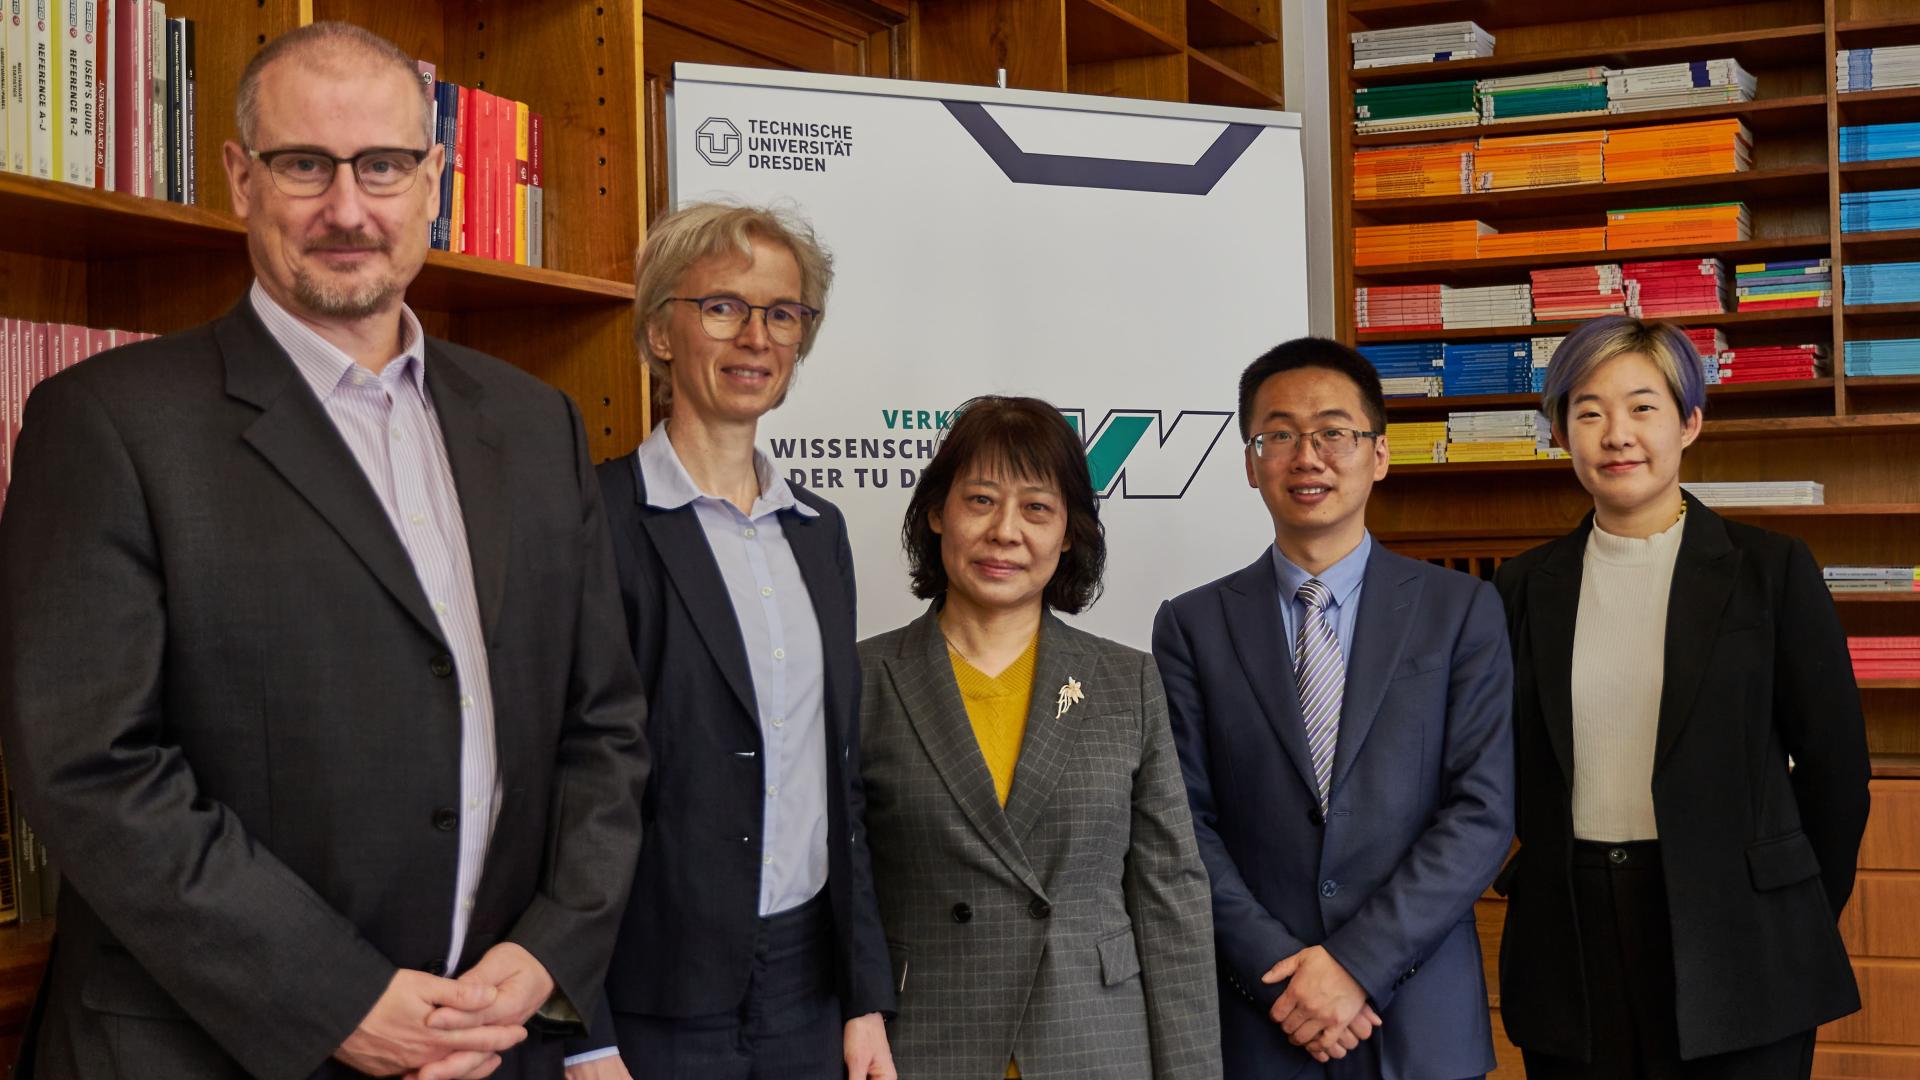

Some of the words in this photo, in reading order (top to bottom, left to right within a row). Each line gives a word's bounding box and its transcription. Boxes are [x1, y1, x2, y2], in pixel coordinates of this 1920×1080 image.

[38, 42, 46, 107] REFERENCE
[70, 49, 78, 113] REFERENCE
[84, 59, 93, 99] USER'S
[70, 117, 78, 137] R-Z
[84, 103, 93, 136] GUIDE
[748, 119, 853, 140] TECHNISCHE
[97, 151, 104, 164] OF
[748, 137, 853, 157] UNIVERSITÄT
[748, 154, 826, 172] DRESDEN
[882, 409, 961, 430] VERK
[770, 438, 943, 459] WISSENSCH
[789, 468, 844, 488] DER
[854, 468, 888, 488] TU
